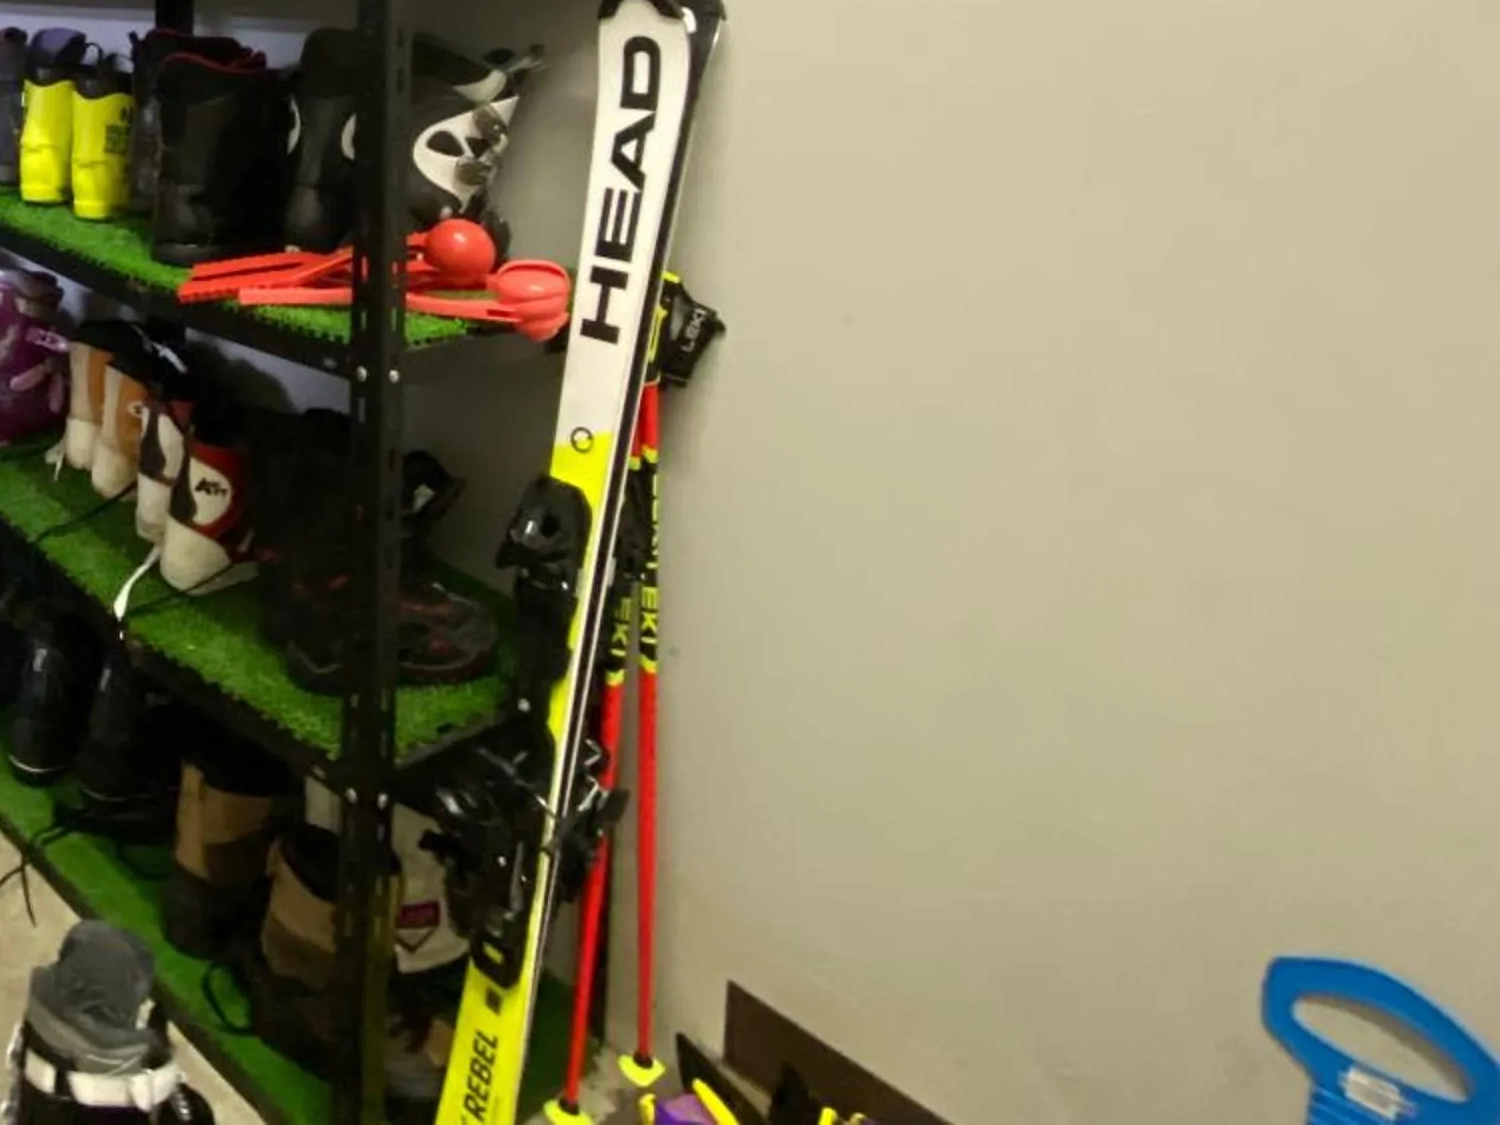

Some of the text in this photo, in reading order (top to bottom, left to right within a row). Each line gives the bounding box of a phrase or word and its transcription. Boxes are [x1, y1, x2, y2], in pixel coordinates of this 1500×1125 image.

[580, 35, 661, 346] HEAD
[681, 307, 705, 354] LEKI
[463, 1029, 498, 1122] REBEL
